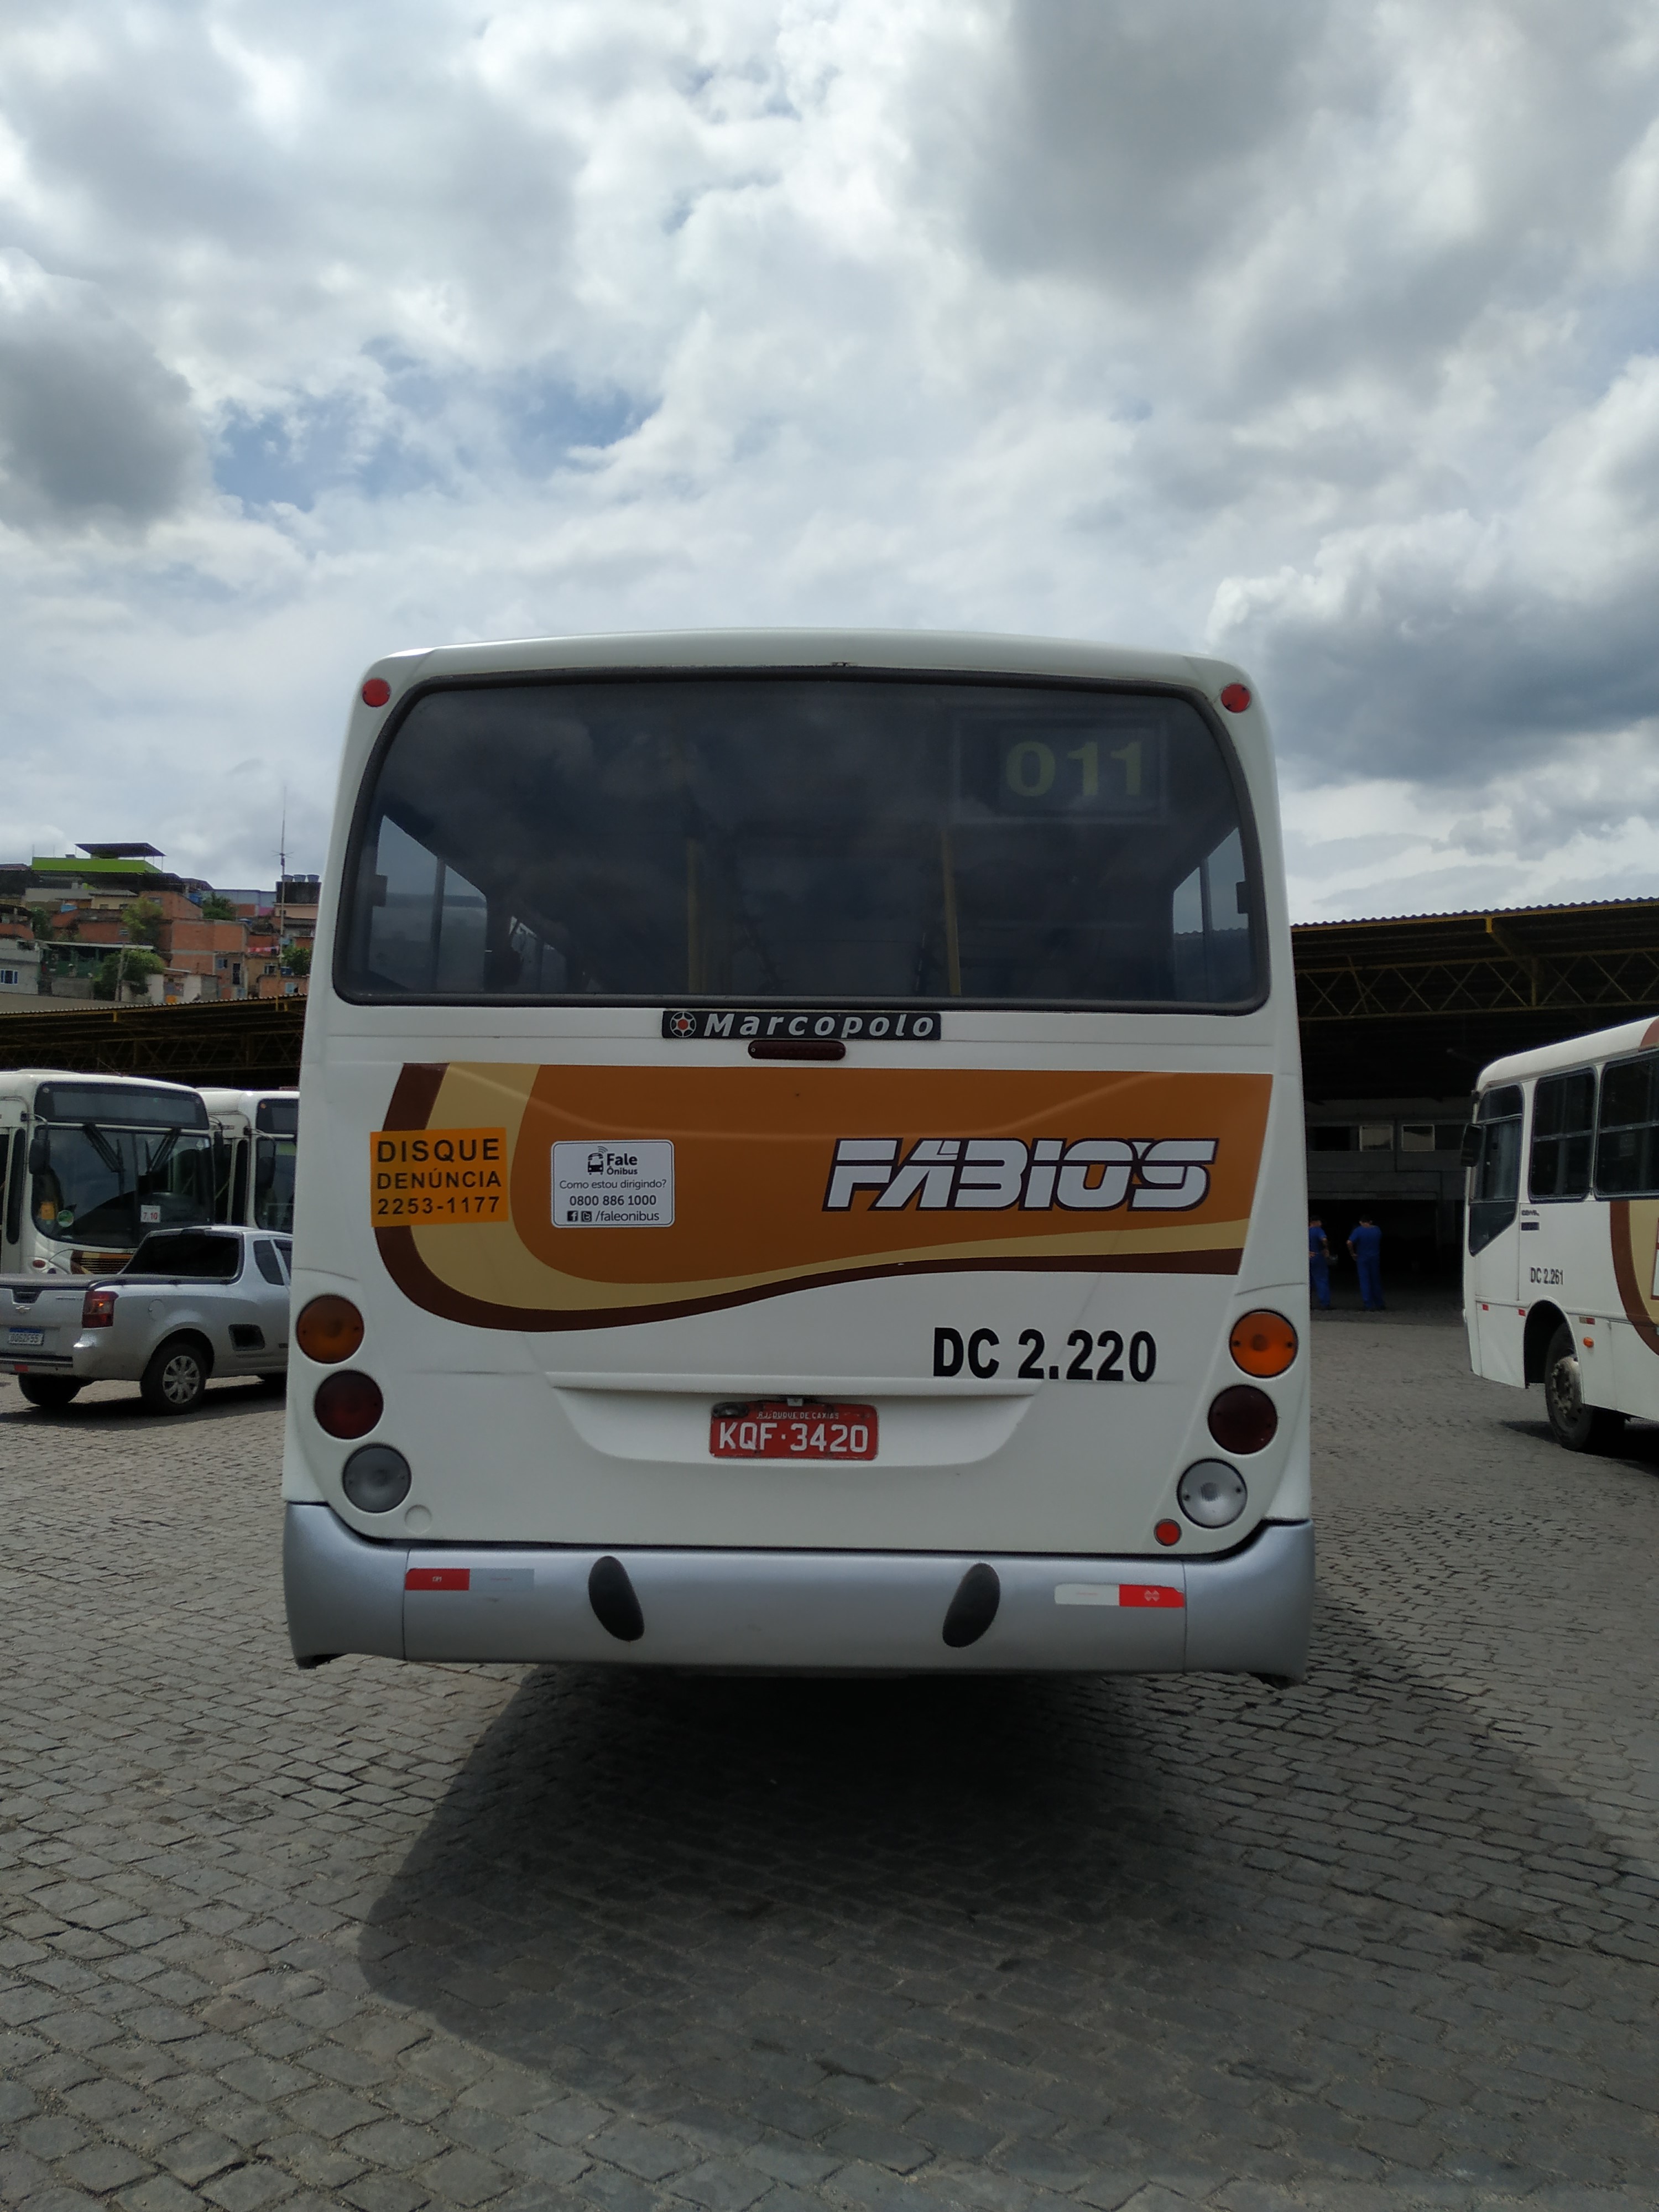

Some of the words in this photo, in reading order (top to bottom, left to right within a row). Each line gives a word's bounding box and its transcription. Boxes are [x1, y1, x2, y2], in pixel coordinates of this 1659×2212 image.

[1006, 740, 1142, 797] 011
[704, 1013, 934, 1038] Marcopolo
[377, 1138, 500, 1162] DISQUE
[607, 1153, 638, 1166] Fale
[377, 1168, 502, 1190] DENÚNCIA
[606, 1166, 638, 1175] Ônibus
[559, 1180, 589, 1190] Como
[591, 1180, 618, 1188] estou
[620, 1179, 667, 1190] dirigindo?
[377, 1196, 500, 1215] 2253-1177
[569, 1195, 599, 1206] 0800
[602, 1195, 625, 1206] 886
[628, 1194, 657, 1206] 1000
[595, 1210, 660, 1222] /faleonibus
[1530, 1267, 1542, 1284] DC
[1543, 1268, 1563, 1285] 2.261
[933, 1326, 1000, 1378] DC
[1018, 1328, 1156, 1383] 2.220
